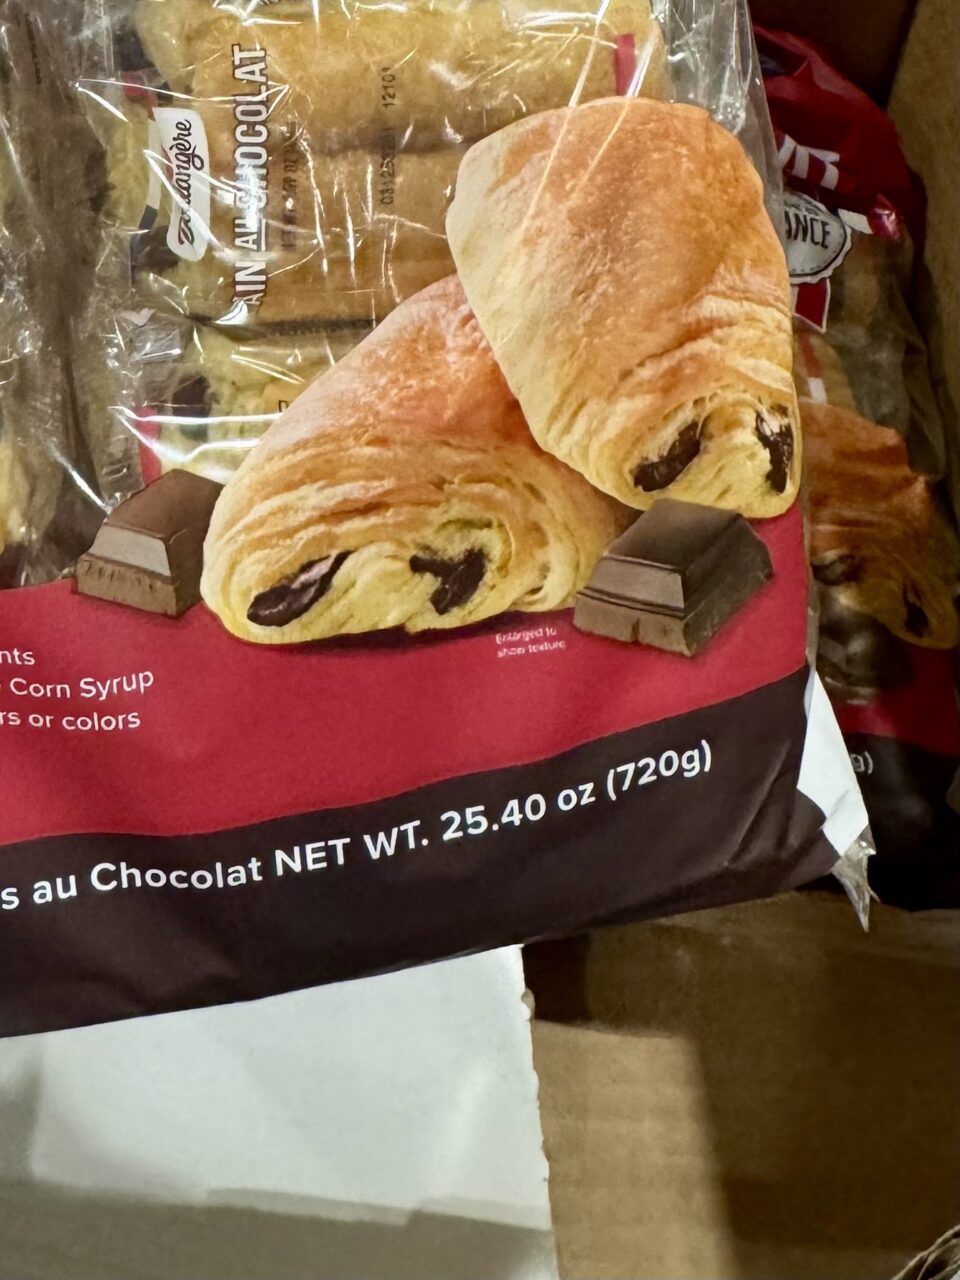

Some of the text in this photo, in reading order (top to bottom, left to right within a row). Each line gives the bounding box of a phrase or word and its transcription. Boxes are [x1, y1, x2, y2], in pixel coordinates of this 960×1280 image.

[9, 677, 71, 699] Corn
[79, 670, 155, 701] Syrup
[28, 712, 53, 728] or
[62, 709, 142, 731] colors
[32, 872, 78, 905] au
[90, 854, 263, 892] Chocolat
[274, 836, 351, 877] NET
[363, 819, 429, 862] WT.
[439, 793, 548, 842] 25.40
[556, 780, 596, 812] oz
[606, 738, 713, 802] (720g)
